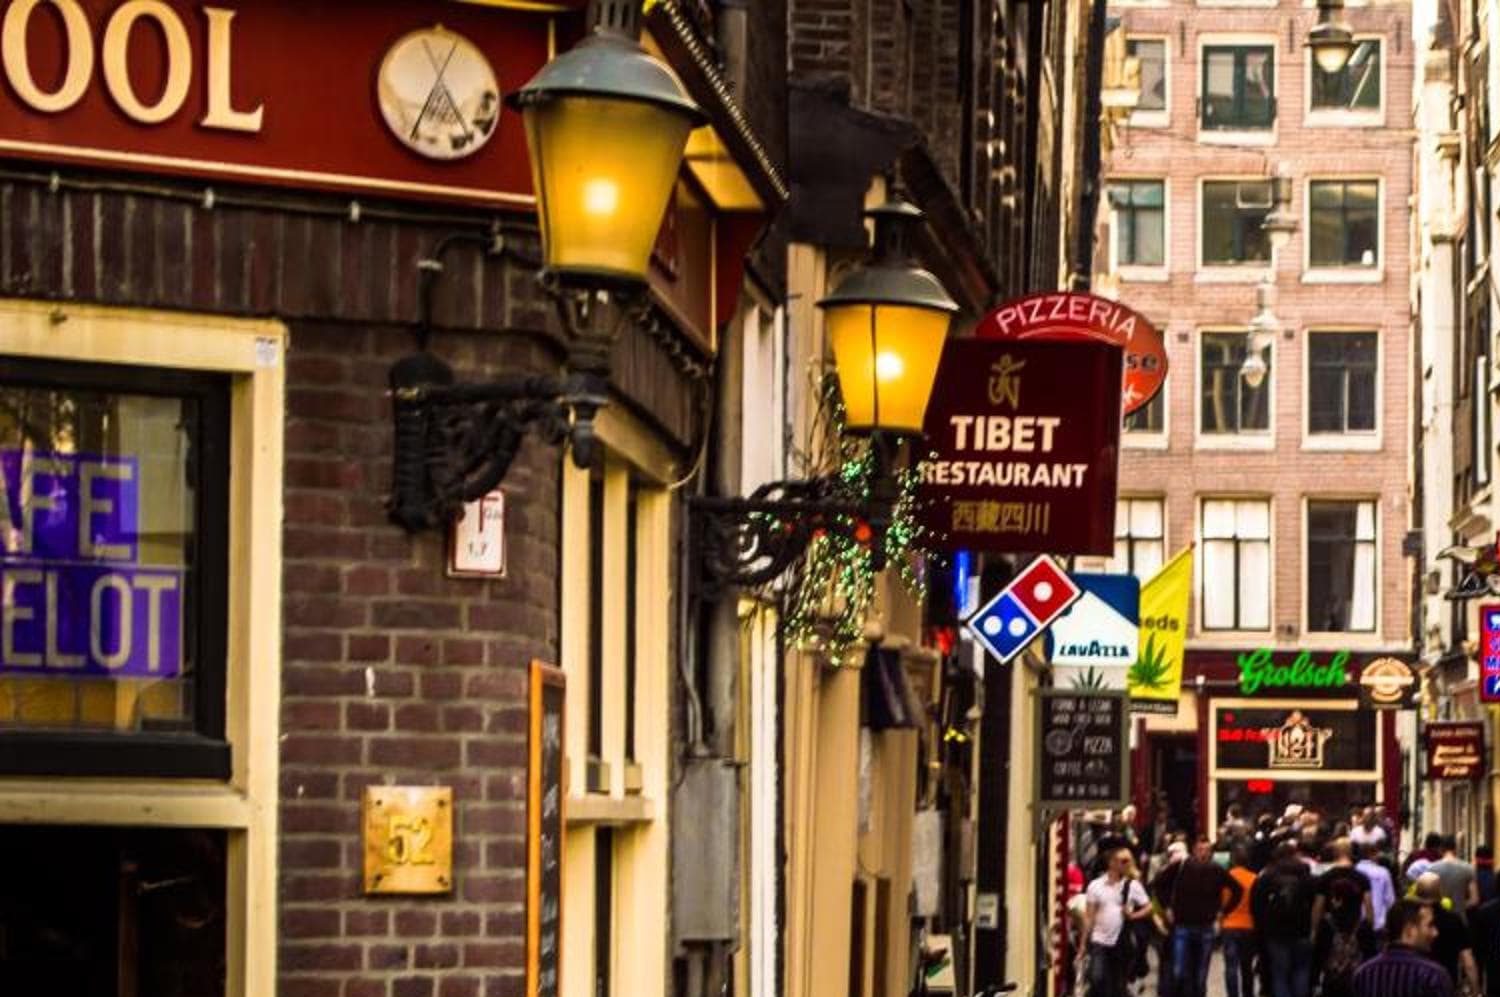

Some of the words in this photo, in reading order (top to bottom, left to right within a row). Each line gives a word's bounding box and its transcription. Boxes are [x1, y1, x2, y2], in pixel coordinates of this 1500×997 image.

[996, 295, 1137, 341] PIZZERIA
[950, 415, 1061, 453] TIBET
[918, 460, 1088, 489] RESTAURANT
[1059, 640, 1130, 657] LAVAZZA
[1237, 648, 1351, 695] Grolsch
[388, 815, 436, 866] 52
